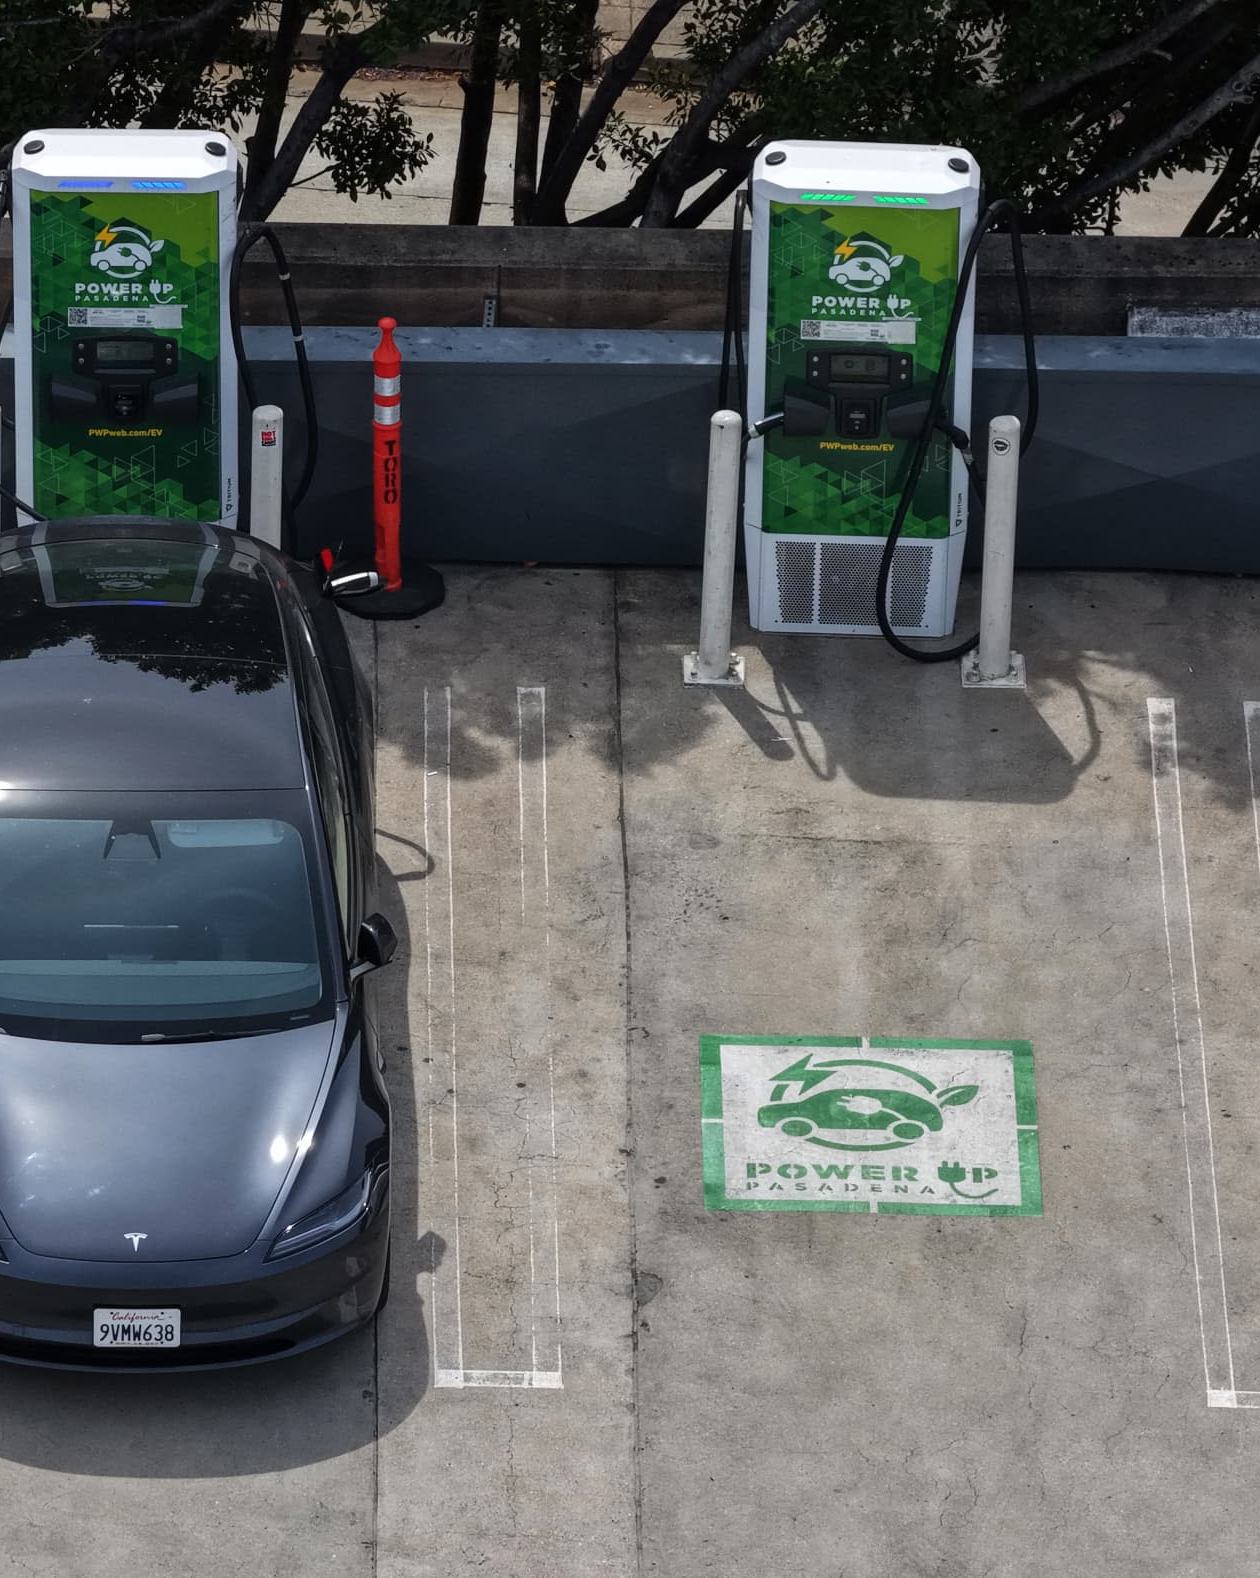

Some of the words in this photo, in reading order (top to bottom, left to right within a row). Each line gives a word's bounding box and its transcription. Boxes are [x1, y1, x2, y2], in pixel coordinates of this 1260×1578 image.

[75, 283, 142, 294] POWER
[812, 295, 880, 309] POWER
[811, 308, 886, 316] PASADENA
[383, 439, 397, 505] TORO
[745, 1162, 920, 1182] POWER
[745, 1182, 936, 1195] PASADENA
[111, 1311, 164, 1323] California
[99, 1323, 175, 1342] 9VMW638
